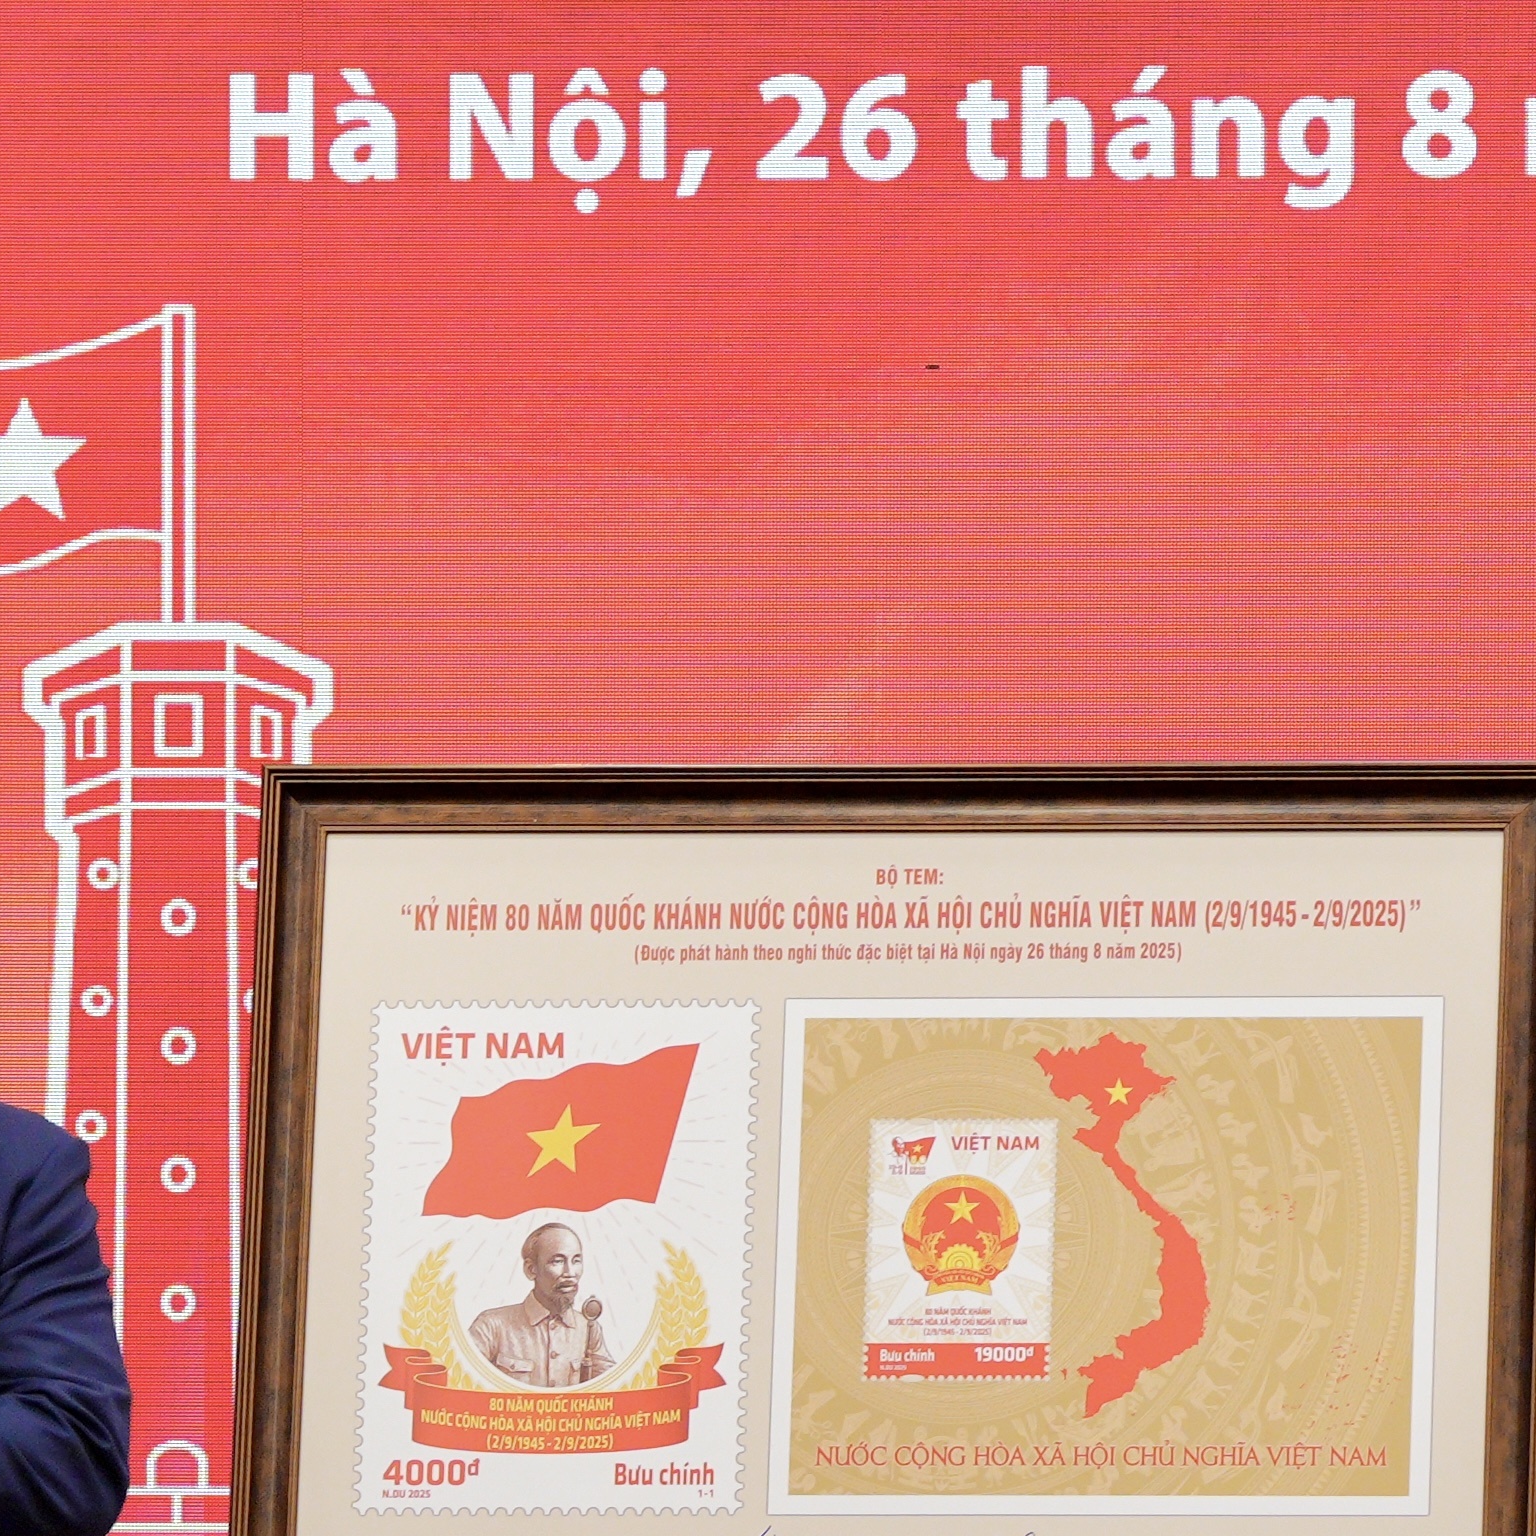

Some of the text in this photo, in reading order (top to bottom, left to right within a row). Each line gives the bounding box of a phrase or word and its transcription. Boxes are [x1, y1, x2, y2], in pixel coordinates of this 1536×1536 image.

[227, 66, 400, 183] Hà
[447, 66, 714, 215] Nội,
[754, 73, 920, 183] 26
[954, 64, 1357, 212] tháng
[1400, 70, 1478, 180] 8
[875, 864, 944, 889] BỘ TEM:
[445, 897, 498, 937] NIỆM
[505, 907, 530, 931] 80
[537, 899, 583, 931] NĂM
[589, 894, 646, 934] QUỐC
[653, 896, 722, 930] KHÁNH
[729, 895, 786, 930] NƯỚC
[792, 895, 849, 936] CỘNG
[855, 895, 898, 930] HÒA
[904, 895, 930, 929] XÃ
[937, 895, 973, 935] HỘI
[979, 893, 1022, 929] CHỦ
[1029, 894, 1093, 928] NGHĨA
[1098, 894, 1145, 935] VIỆT
[1151, 900, 1197, 928] NAM
[634, 942, 1183, 965] (Được phát hành theo nghi thức đặc biệt tại Hà Nội ngày 26 tháng 8 năm 2025)
[401, 1026, 565, 1066] VIỆT NAM
[951, 1132, 1040, 1155] VIỆT NAM
[879, 1348, 936, 1362] Bưu chính
[489, 1395, 613, 1414] 80 NĂM QUỐC KHÁNH
[420, 1408, 682, 1435] NƯỚC CỘNG HÒA XÃ HỘI CHỦ NGHĨA VIỆT NAM
[814, 1439, 1388, 1470] NƯỚC CỘNG HÒA XÃ HỘI CHỦ NGHĨA VIỆT NAM
[382, 1458, 480, 1486] 4000đ
[614, 1461, 715, 1486] Bưu chính
[408, 1489, 431, 1498] 2025
